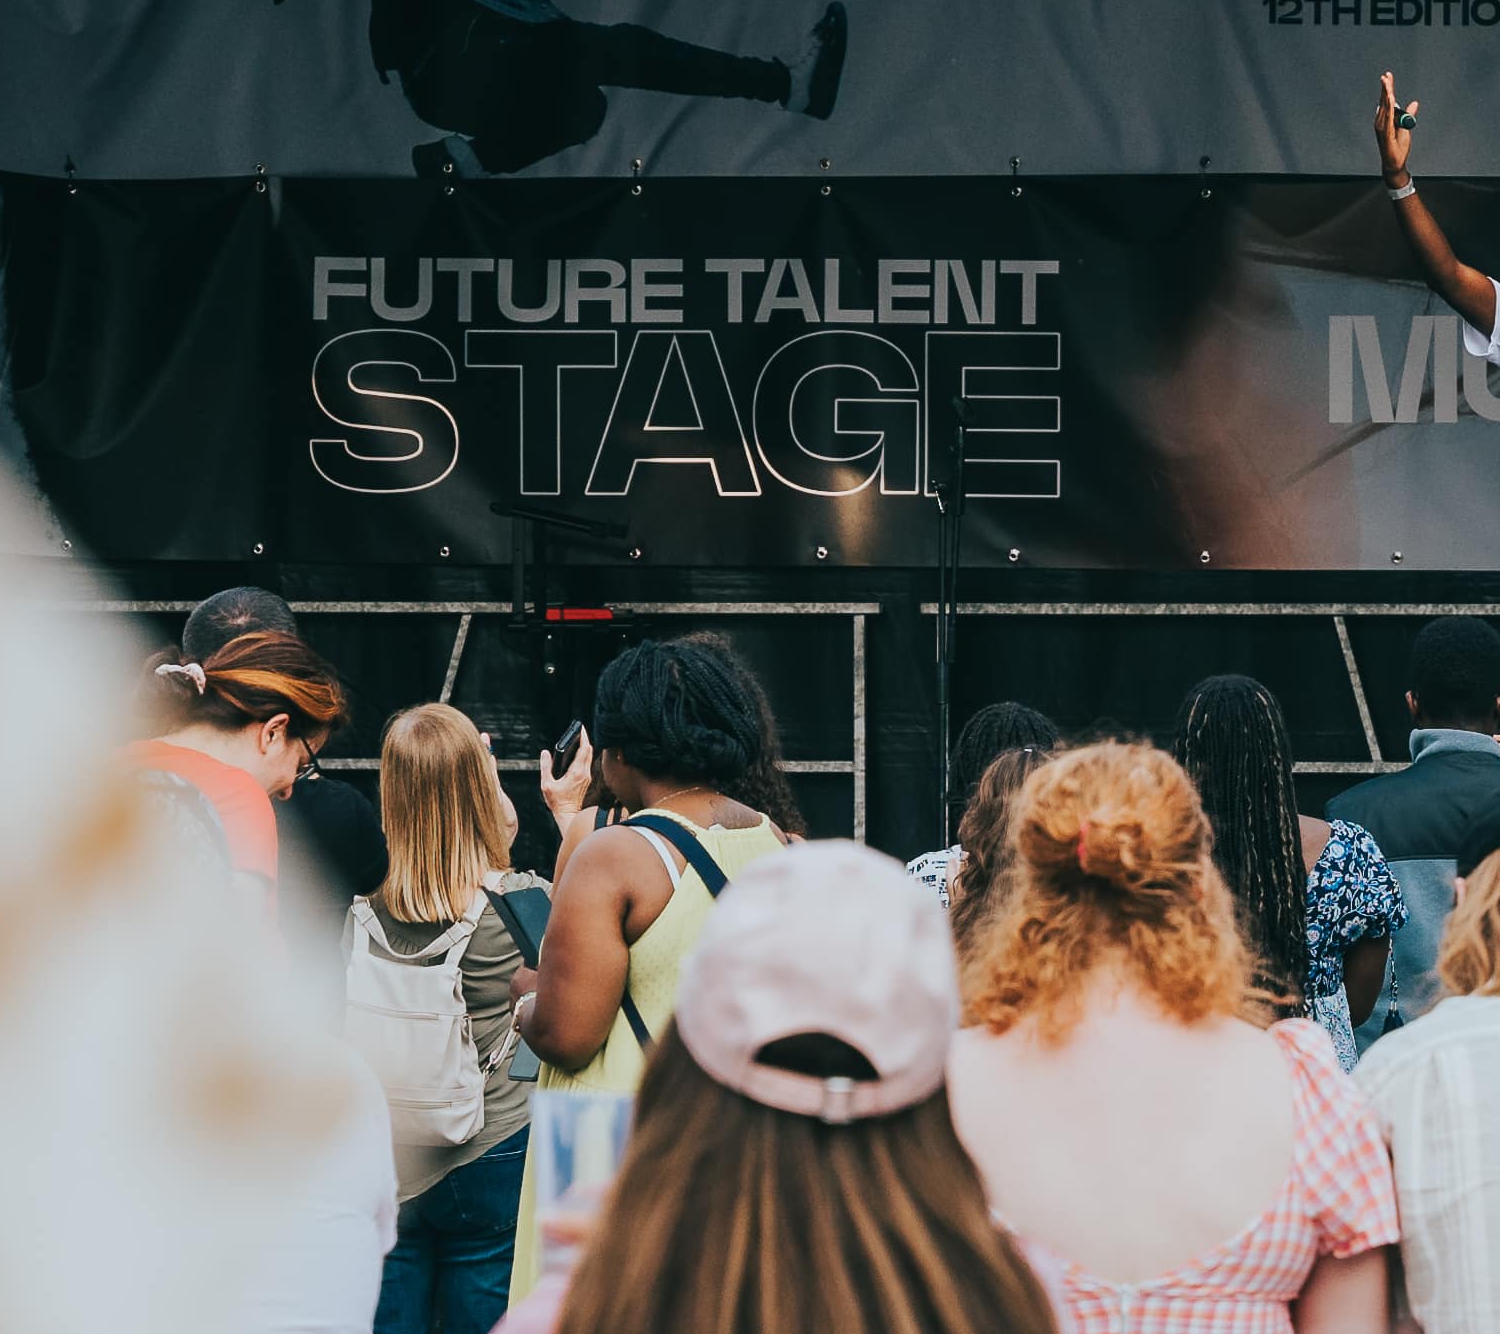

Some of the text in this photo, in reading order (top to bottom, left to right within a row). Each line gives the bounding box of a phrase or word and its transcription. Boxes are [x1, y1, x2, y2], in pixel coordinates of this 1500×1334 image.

[312, 256, 1060, 324] FUTURE TALENT
[310, 329, 1061, 497] STAGE
